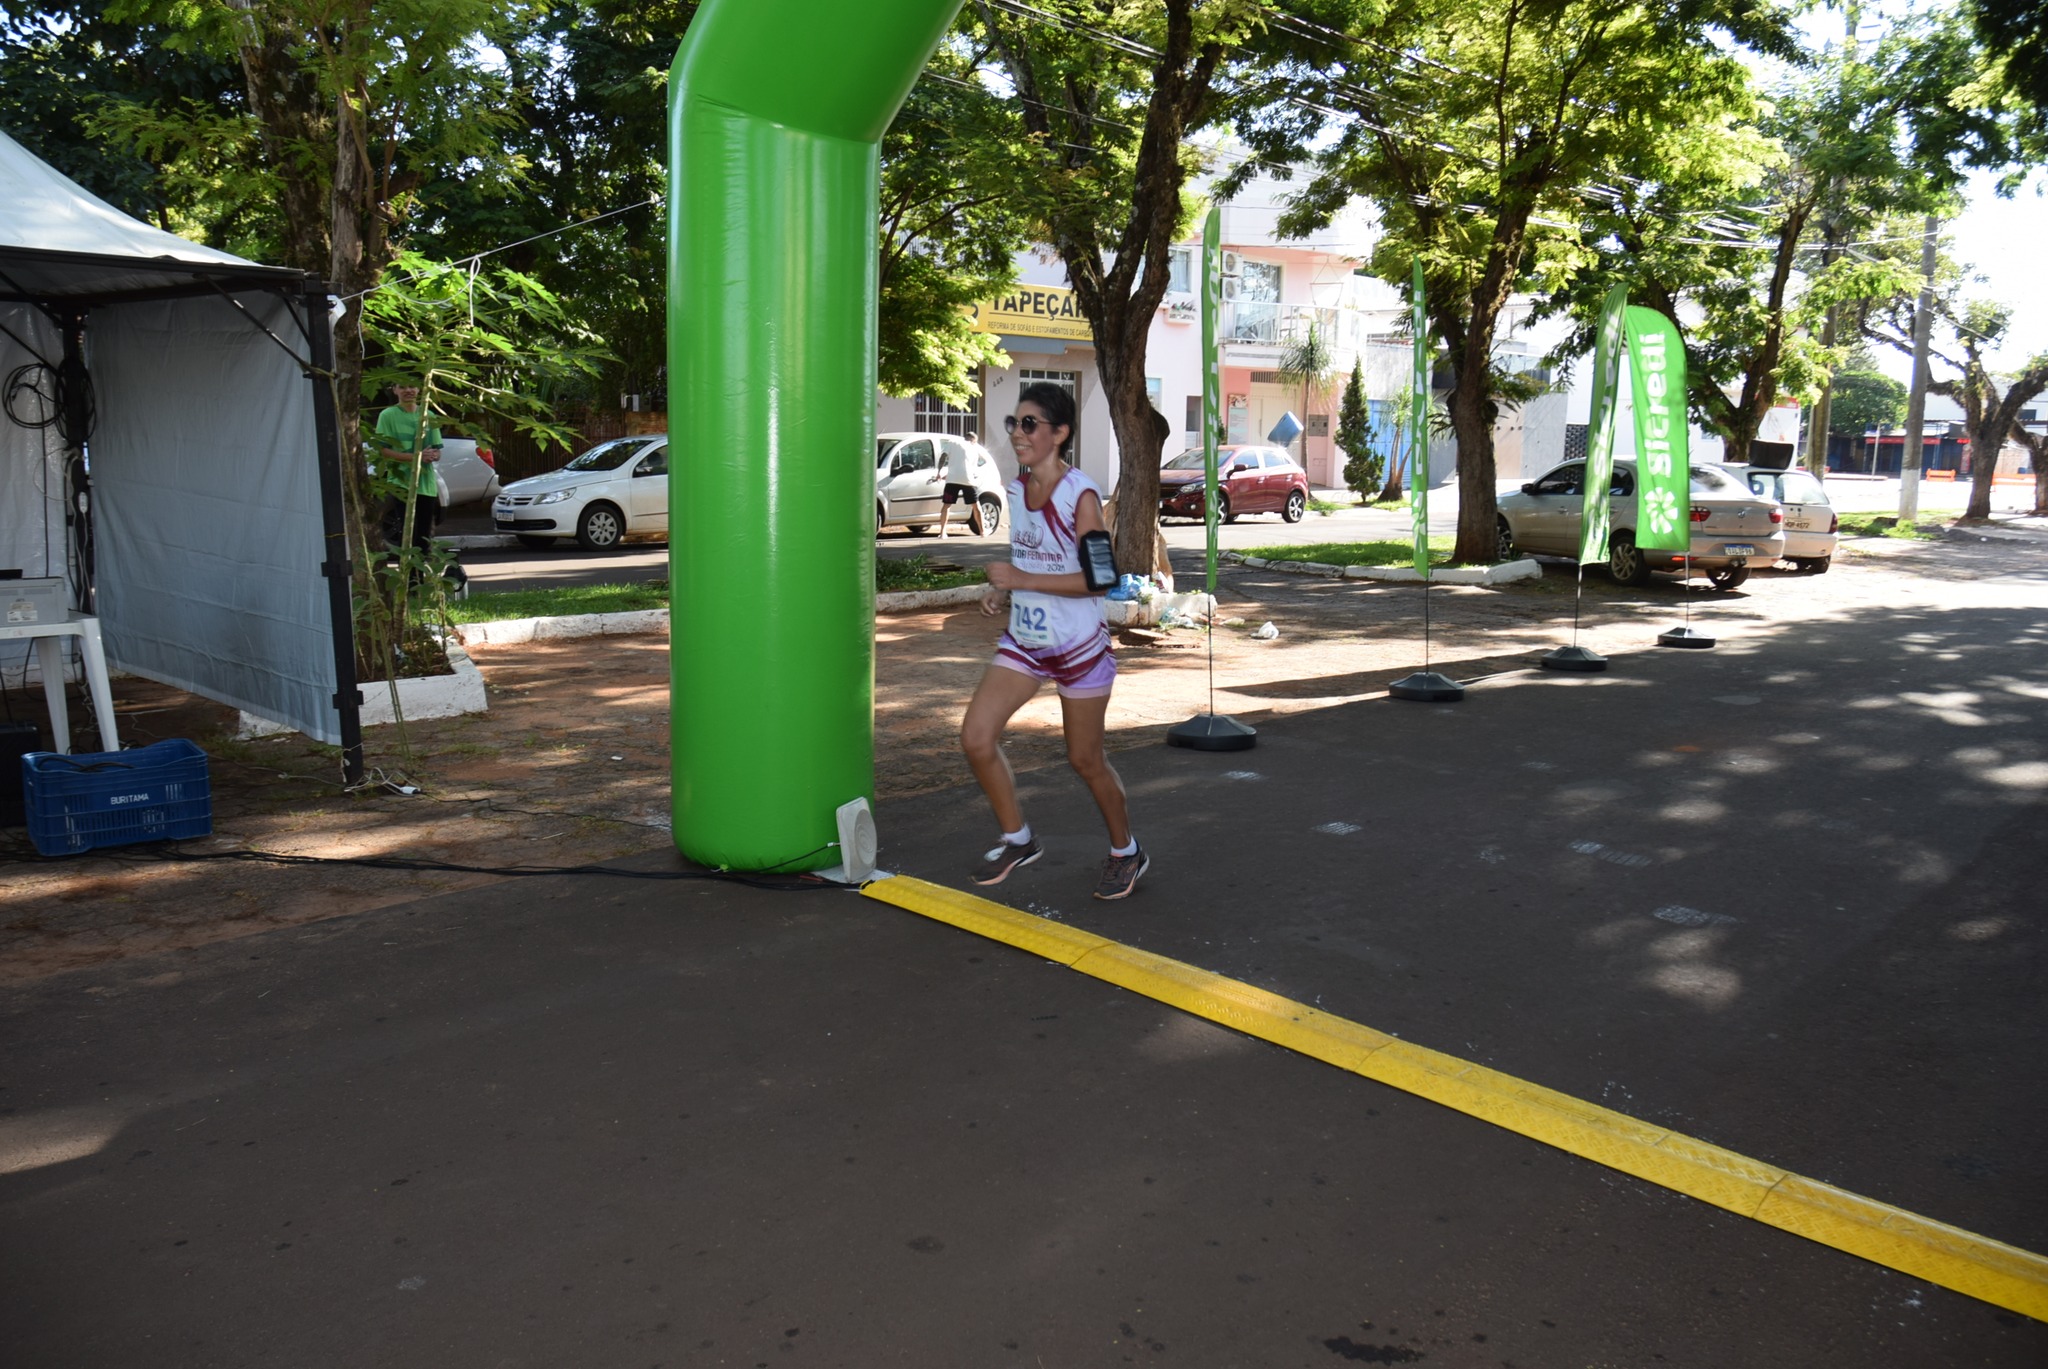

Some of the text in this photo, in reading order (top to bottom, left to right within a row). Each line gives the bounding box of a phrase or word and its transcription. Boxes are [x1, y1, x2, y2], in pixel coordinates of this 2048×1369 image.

[987, 321, 1009, 330] REFORMA
[1017, 323, 1031, 332] SOFÁS
[1036, 325, 1068, 335] ESTOFAMENTOS
[1638, 330, 1672, 478] Sicredi
[1027, 551, 1063, 563] FEMININA
[1014, 603, 1047, 631] 742
[110, 793, 149, 805] BURITAMA
